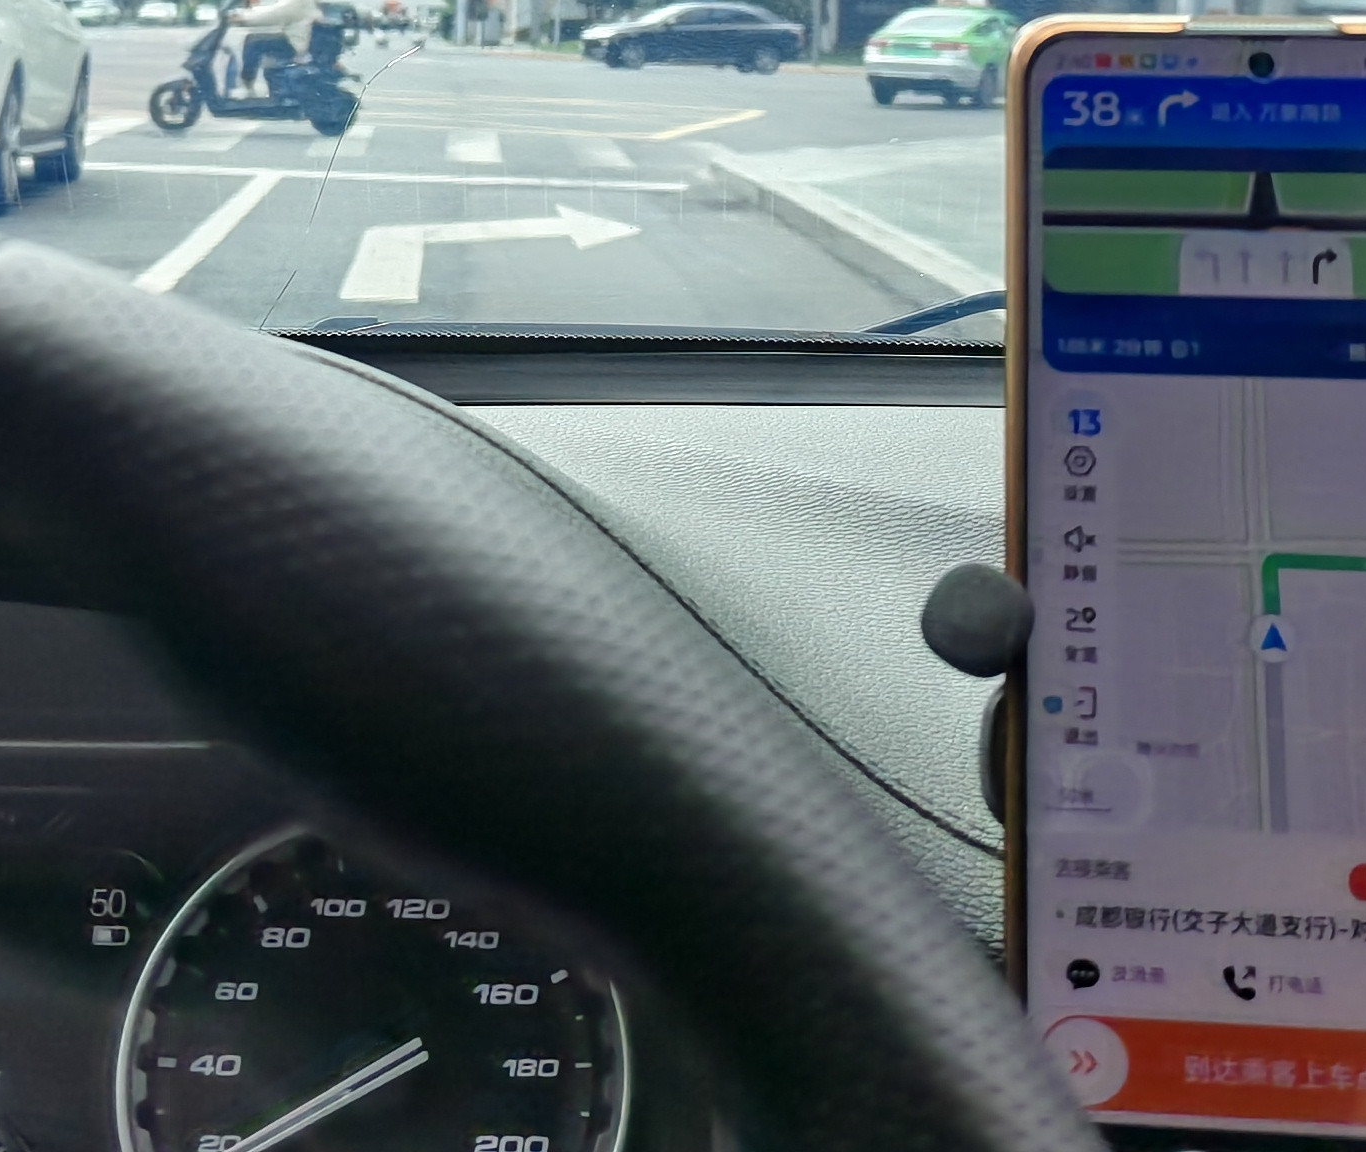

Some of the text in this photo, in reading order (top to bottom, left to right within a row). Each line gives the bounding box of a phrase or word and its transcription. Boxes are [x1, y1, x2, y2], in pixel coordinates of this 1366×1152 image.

[1062, 90, 1122, 128] 38
[1068, 408, 1102, 436] 13
[89, 888, 128, 918] 50
[311, 898, 366, 918] 100
[386, 898, 450, 920] 120
[260, 927, 311, 949] 80
[443, 930, 499, 950] 140
[214, 982, 259, 1002] 60
[472, 983, 540, 1006] 160
[189, 1054, 242, 1076] 40
[502, 1058, 560, 1078] 180
[474, 1135, 549, 1152] 200
